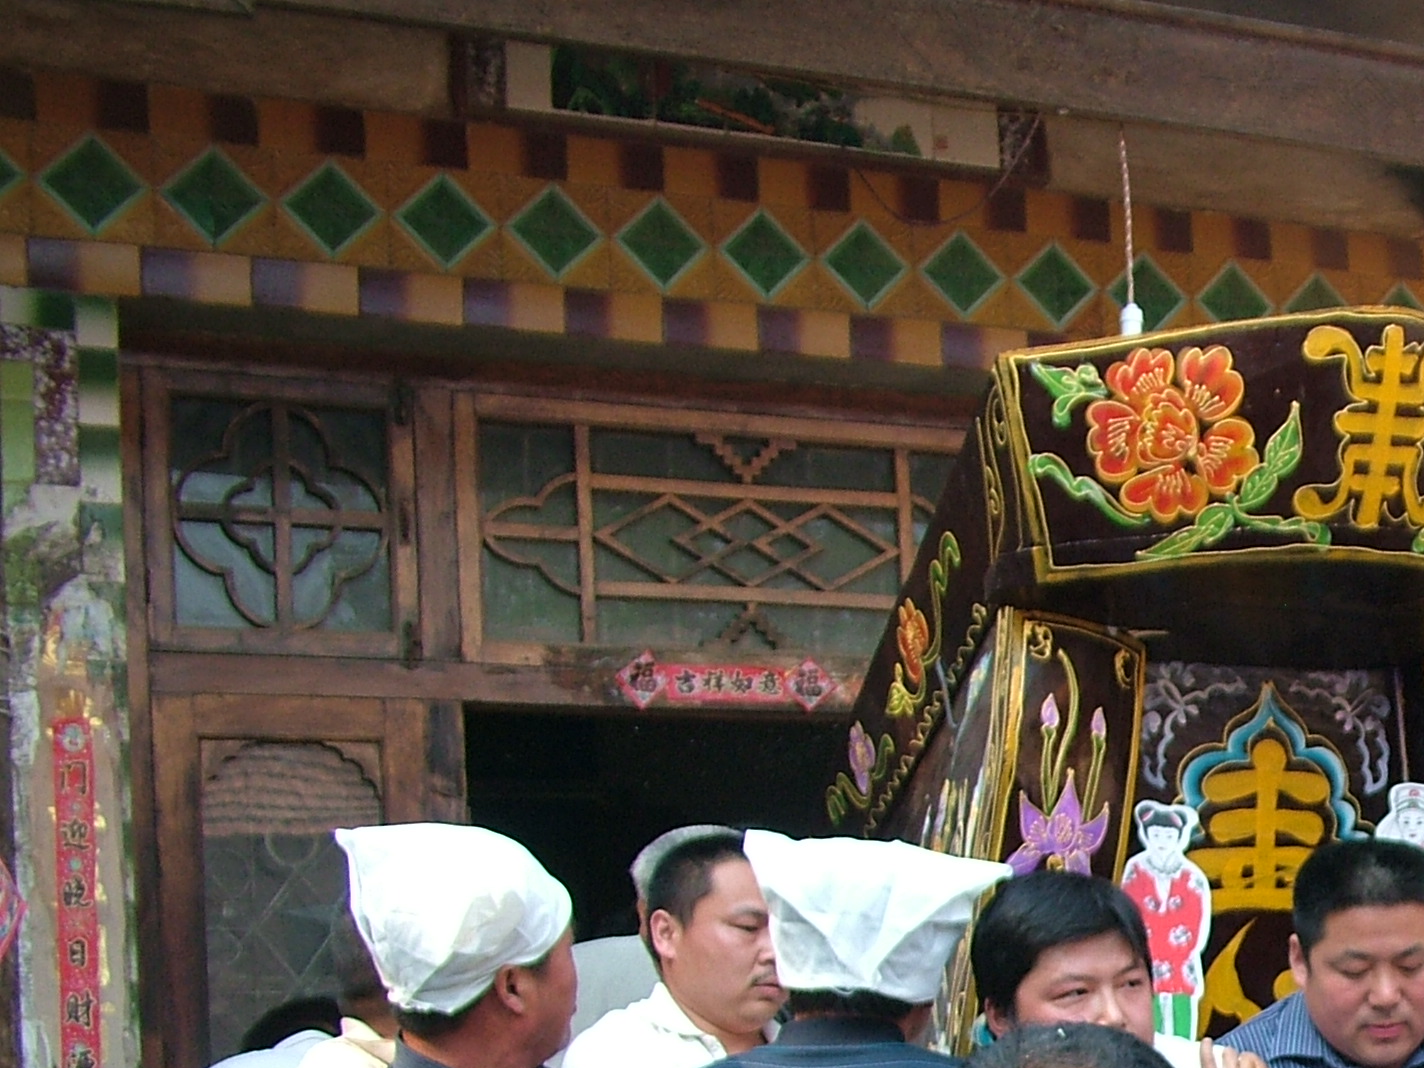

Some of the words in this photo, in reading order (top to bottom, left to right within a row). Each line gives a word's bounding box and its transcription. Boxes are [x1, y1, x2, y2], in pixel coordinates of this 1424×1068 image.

[674, 668, 783, 697] 吉祥如意
[794, 668, 824, 699] 福
